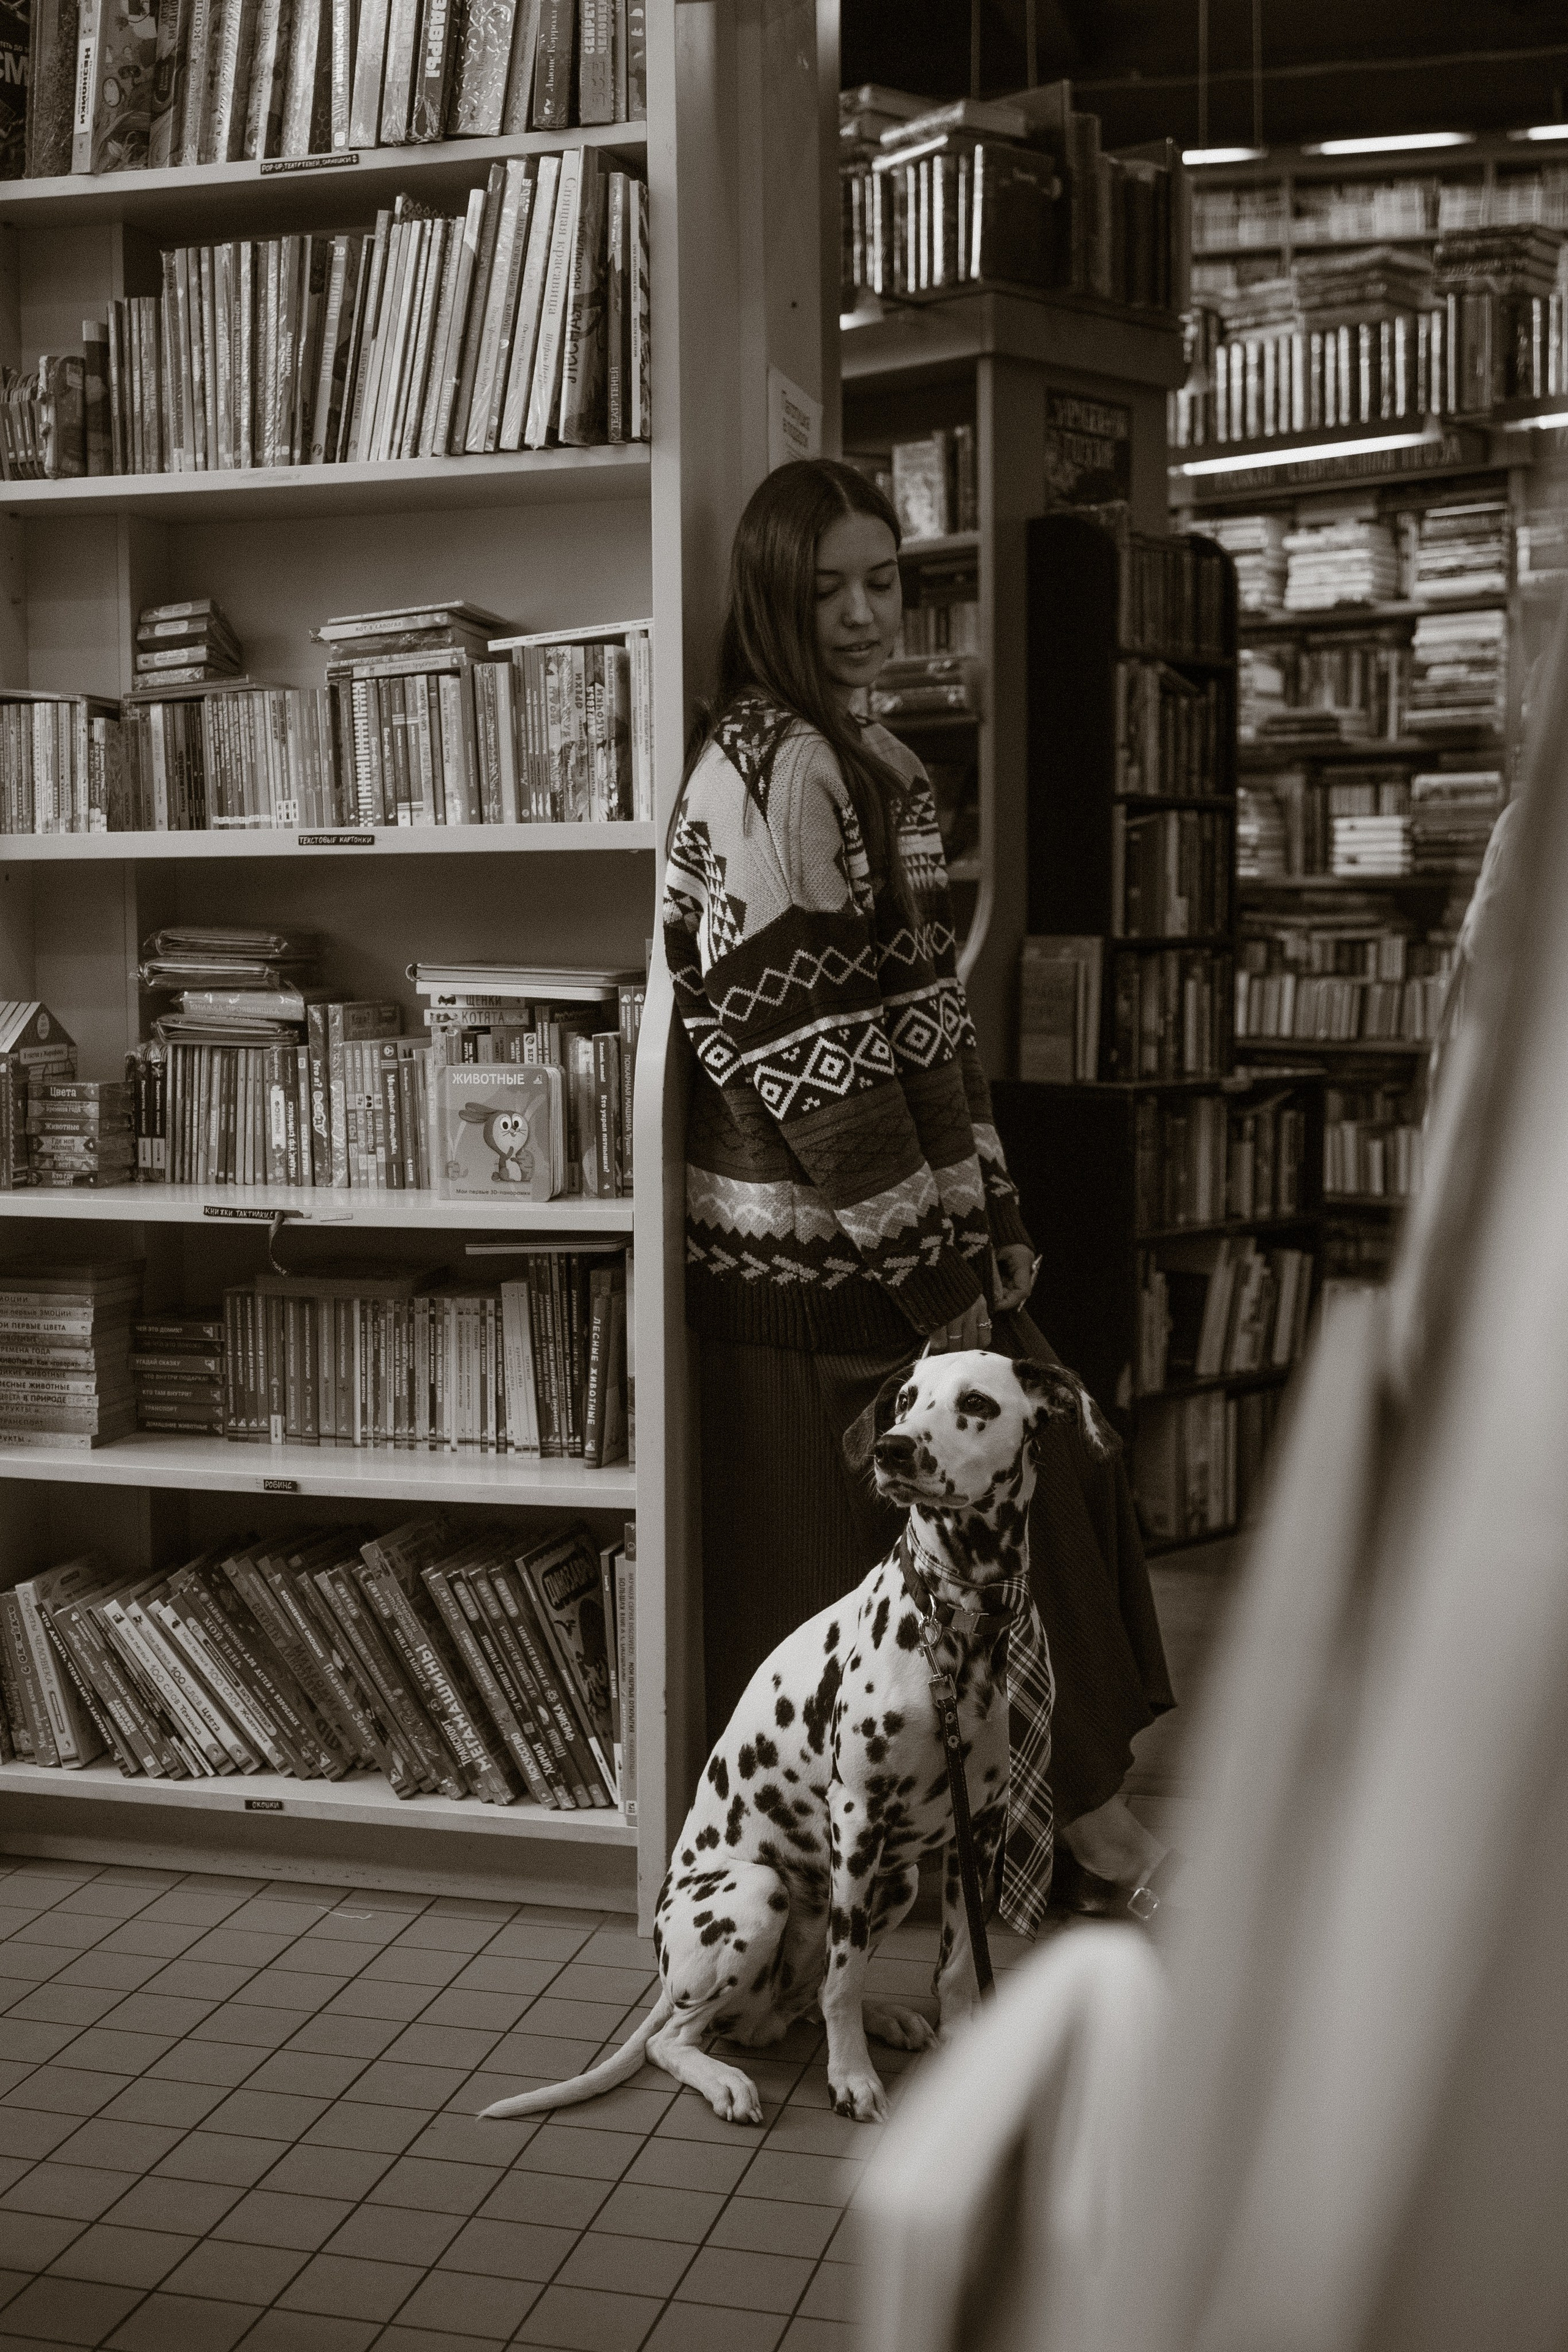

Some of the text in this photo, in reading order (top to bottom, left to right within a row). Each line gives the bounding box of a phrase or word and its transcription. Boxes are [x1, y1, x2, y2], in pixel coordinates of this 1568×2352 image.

[544, 175, 577, 316] Спящая красавица
[284, 331, 293, 377] ДИНОЗАВРЫ
[609, 366, 618, 398] ТЕНЕЙ
[572, 672, 584, 709] ОРЕХИ
[586, 685, 596, 736] ДЕРЕВЬЯ
[595, 687, 605, 739] БАБОЧКИ
[462, 1012, 505, 1023] КОТЯТА
[50, 1087, 76, 1097] Цвета
[452, 1073, 525, 1085] ЖИВОТНЫЕ
[45, 1123, 79, 1132] Животные
[365, 1110, 374, 1152] БЛИЗНЕЦЫ
[600, 1109, 608, 1132] украл
[204, 1207, 233, 1216] КНИЖКИ
[497, 1321, 502, 1330] ДО
[586, 1316, 601, 1425] ЛЕСНЫЕ ЖИВОТНЫЕ
[29, 1394, 67, 1403] ПРИРОДЕ
[264, 1480, 293, 1489] РОБИНС
[202, 1616, 243, 1669] МОЙ ДЕНЬ
[279, 1589, 325, 1659] ВОЛШЕБНЫЕ ОКОШКИ
[32, 1633, 54, 1686] ЧЕЛОВЕКА
[206, 1600, 301, 1727] ТАЙНЫ КОСМОСА ДЛЯ ДЕТЕЙ ВЗРОСЛЫХ
[100, 1659, 127, 1697] ПОЖАРНАЯ
[122, 1694, 146, 1726] МАШИНА
[110, 1697, 140, 1733] ПЛАНЕТУ
[148, 1662, 165, 1684] 100
[176, 1703, 202, 1737] Техника
[169, 1664, 187, 1686] 100
[200, 1706, 222, 1733] Цвета
[207, 1667, 225, 1687] 100
[238, 1707, 269, 1745] Животные
[321, 1662, 380, 1748] Планета Земля
[413, 1643, 493, 1773] МЕГАМАШИНЫ
[104, 1700, 134, 1737] СОХРАНИ
[549, 1702, 577, 1743] ФИЗИКА
[440, 1716, 473, 1768] ТРАНСПОРТ
[509, 1730, 541, 1782] ИСКУССТВО
[530, 1740, 556, 1777] ХИМИЯ
